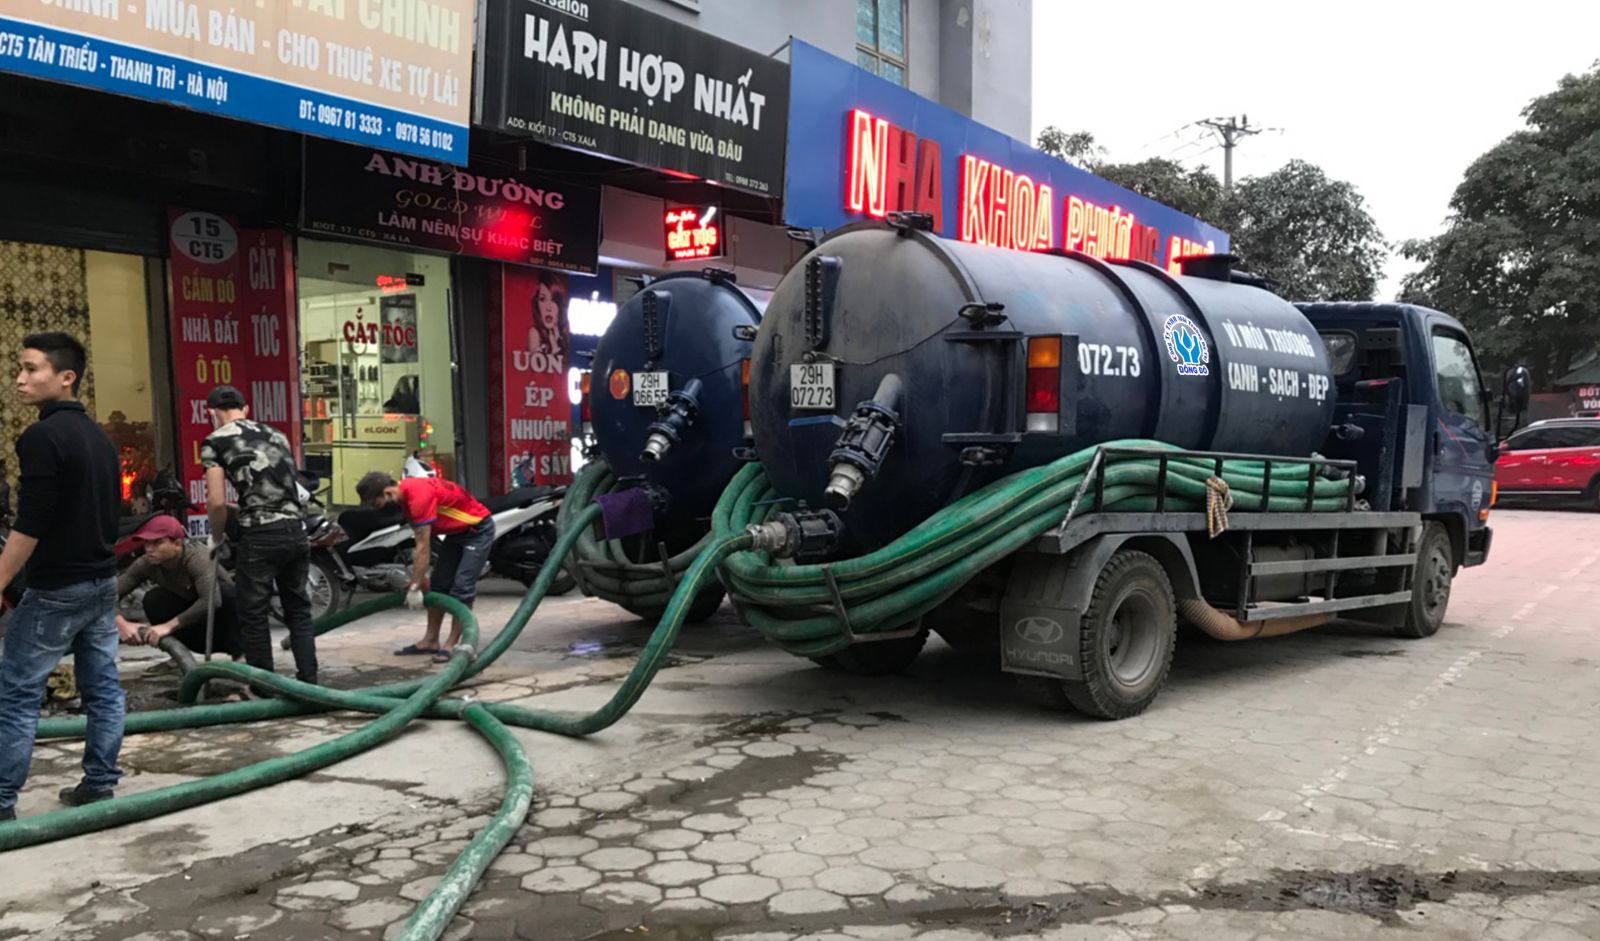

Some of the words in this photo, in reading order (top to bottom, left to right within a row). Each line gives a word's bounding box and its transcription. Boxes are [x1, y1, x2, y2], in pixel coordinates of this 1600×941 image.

[27, 35, 56, 65] TÂN
[110, 55, 153, 86] THANH
[156, 65, 176, 90] TRÌ
[187, 71, 203, 97] HÀ
[206, 76, 229, 105] NỘI
[146, 0, 201, 41] MUA
[208, 8, 256, 55] BÁN
[278, 29, 320, 71] CHO
[326, 44, 373, 86] THUÊ
[379, 56, 402, 93] XE
[408, 64, 432, 105] TỰ
[433, 69, 459, 107] LÁI
[524, 13, 607, 81] HARI
[618, 46, 685, 106] HỢP
[694, 67, 765, 131] NHẤT
[299, 99, 316, 121] ĐT:
[318, 104, 343, 126] 0967
[344, 110, 356, 131] 81
[358, 113, 382, 136] 3333
[396, 122, 418, 143] 0978
[419, 127, 431, 147] 56
[432, 131, 453, 151] 0102
[507, 117, 527, 130] ADD:
[551, 91, 606, 126] KHÔNG
[609, 105, 645, 137] PHẢI
[648, 119, 686, 146] DẠNG
[689, 129, 715, 157] VỪA
[717, 142, 743, 163] ĐÂU
[364, 152, 443, 187] ANH
[452, 163, 566, 210] ĐƯỜNG
[845, 108, 943, 233] NHA
[958, 154, 1053, 252] KHOA
[395, 189, 469, 214] GOLD
[190, 216, 220, 237] 15
[378, 211, 417, 231] LÀM
[421, 219, 457, 238] NÊN
[461, 226, 484, 246] SỰ
[532, 239, 564, 257] BIỆT
[188, 240, 224, 259] CT5
[182, 312, 212, 343] NHÀ
[214, 311, 240, 344] ĐẤT
[251, 305, 280, 357] TÓC
[343, 307, 379, 345] CẮT
[382, 316, 416, 348] TÓC
[1237, 321, 1269, 351] MÔI
[196, 354, 208, 384] Ô
[212, 354, 232, 384] TÔ
[799, 366, 824, 385] 29H
[1078, 342, 1141, 377] 072.73
[524, 380, 554, 408] ÉP
[640, 374, 660, 389] 29H
[793, 388, 834, 408] 072.73
[1268, 367, 1299, 402] SẠCH
[1308, 373, 1329, 406] ĐẸP
[191, 399, 209, 424] XE
[252, 380, 287, 422] NAM
[540, 448, 569, 475] SẤY
[1006, 648, 1074, 666] HYUNDAI
